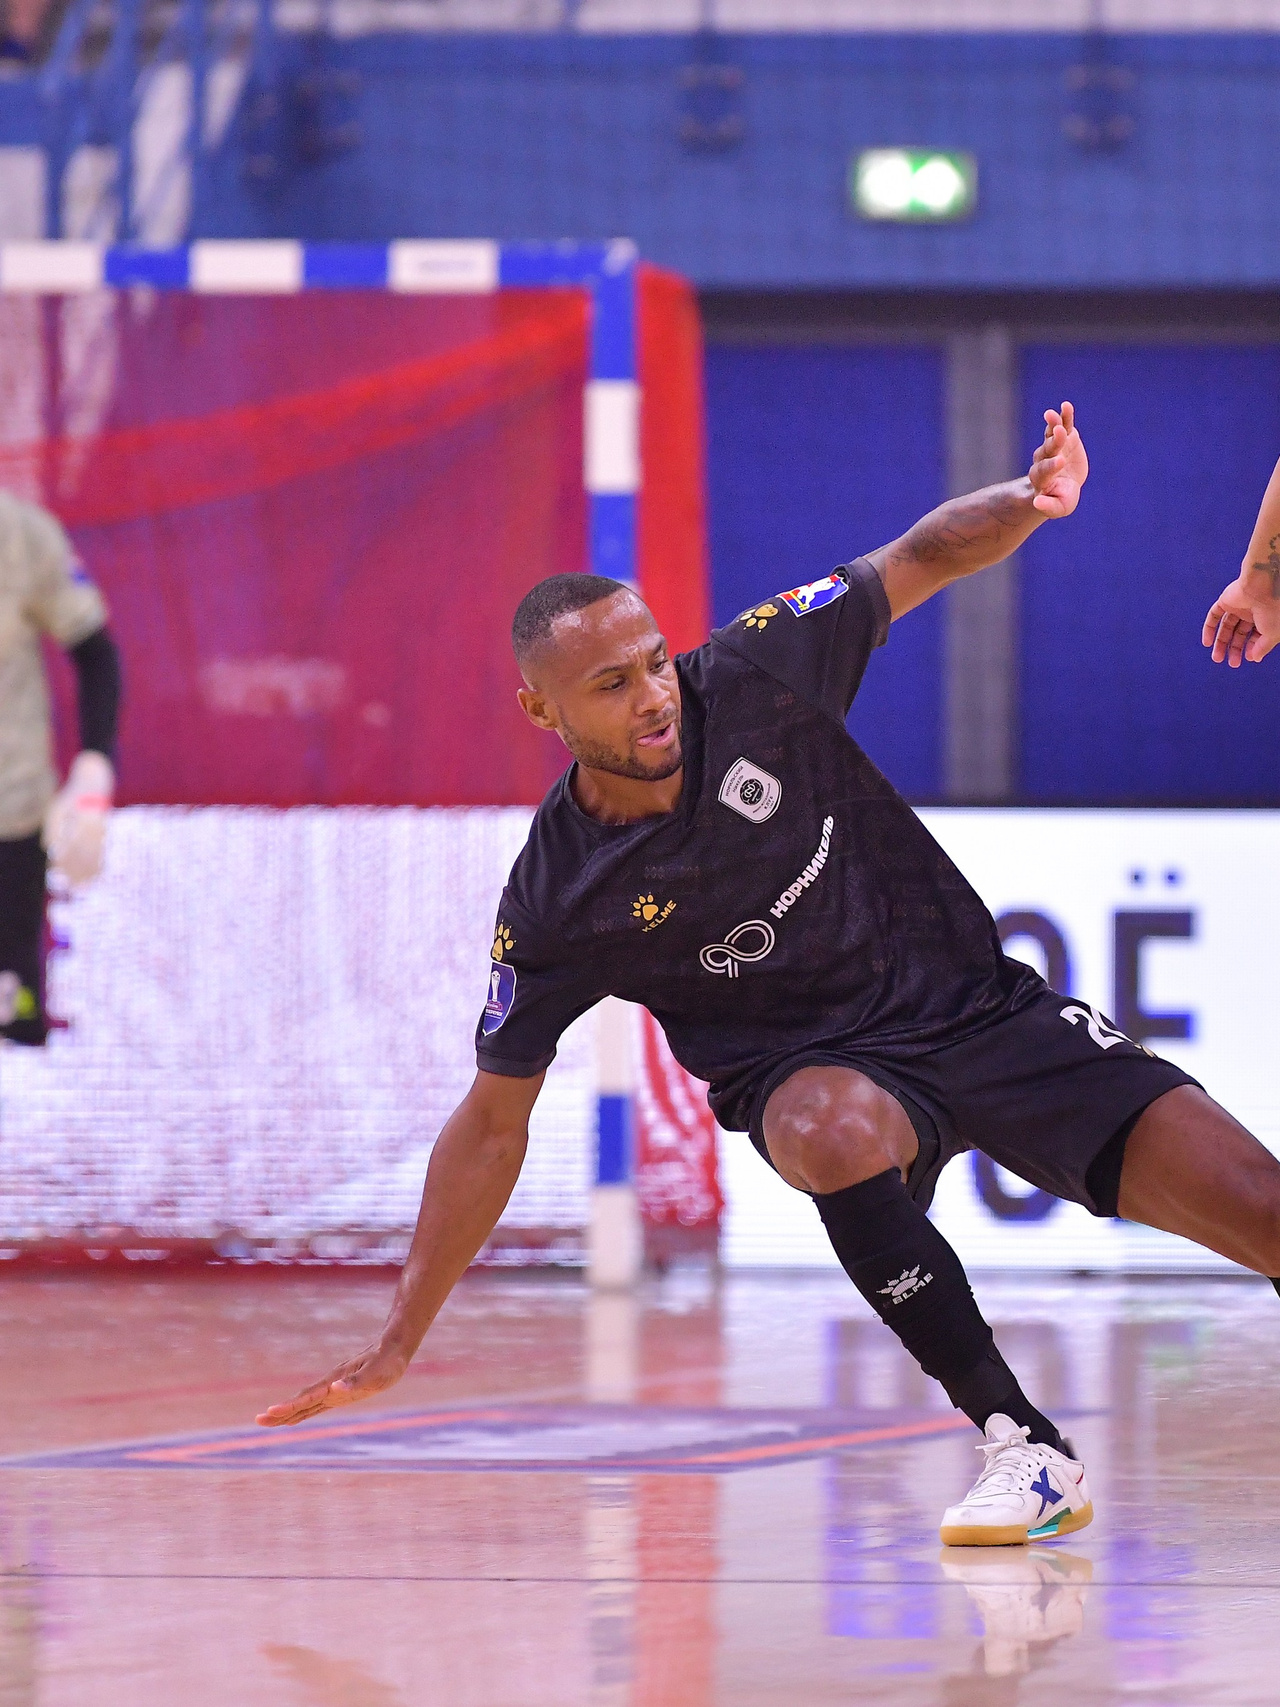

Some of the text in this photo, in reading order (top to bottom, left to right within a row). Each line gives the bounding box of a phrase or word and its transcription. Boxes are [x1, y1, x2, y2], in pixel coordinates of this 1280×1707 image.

[769, 815, 834, 919] НОРНИКЕЛЬ
[641, 899, 677, 933] KELME
[883, 1272, 934, 1306] ELME
